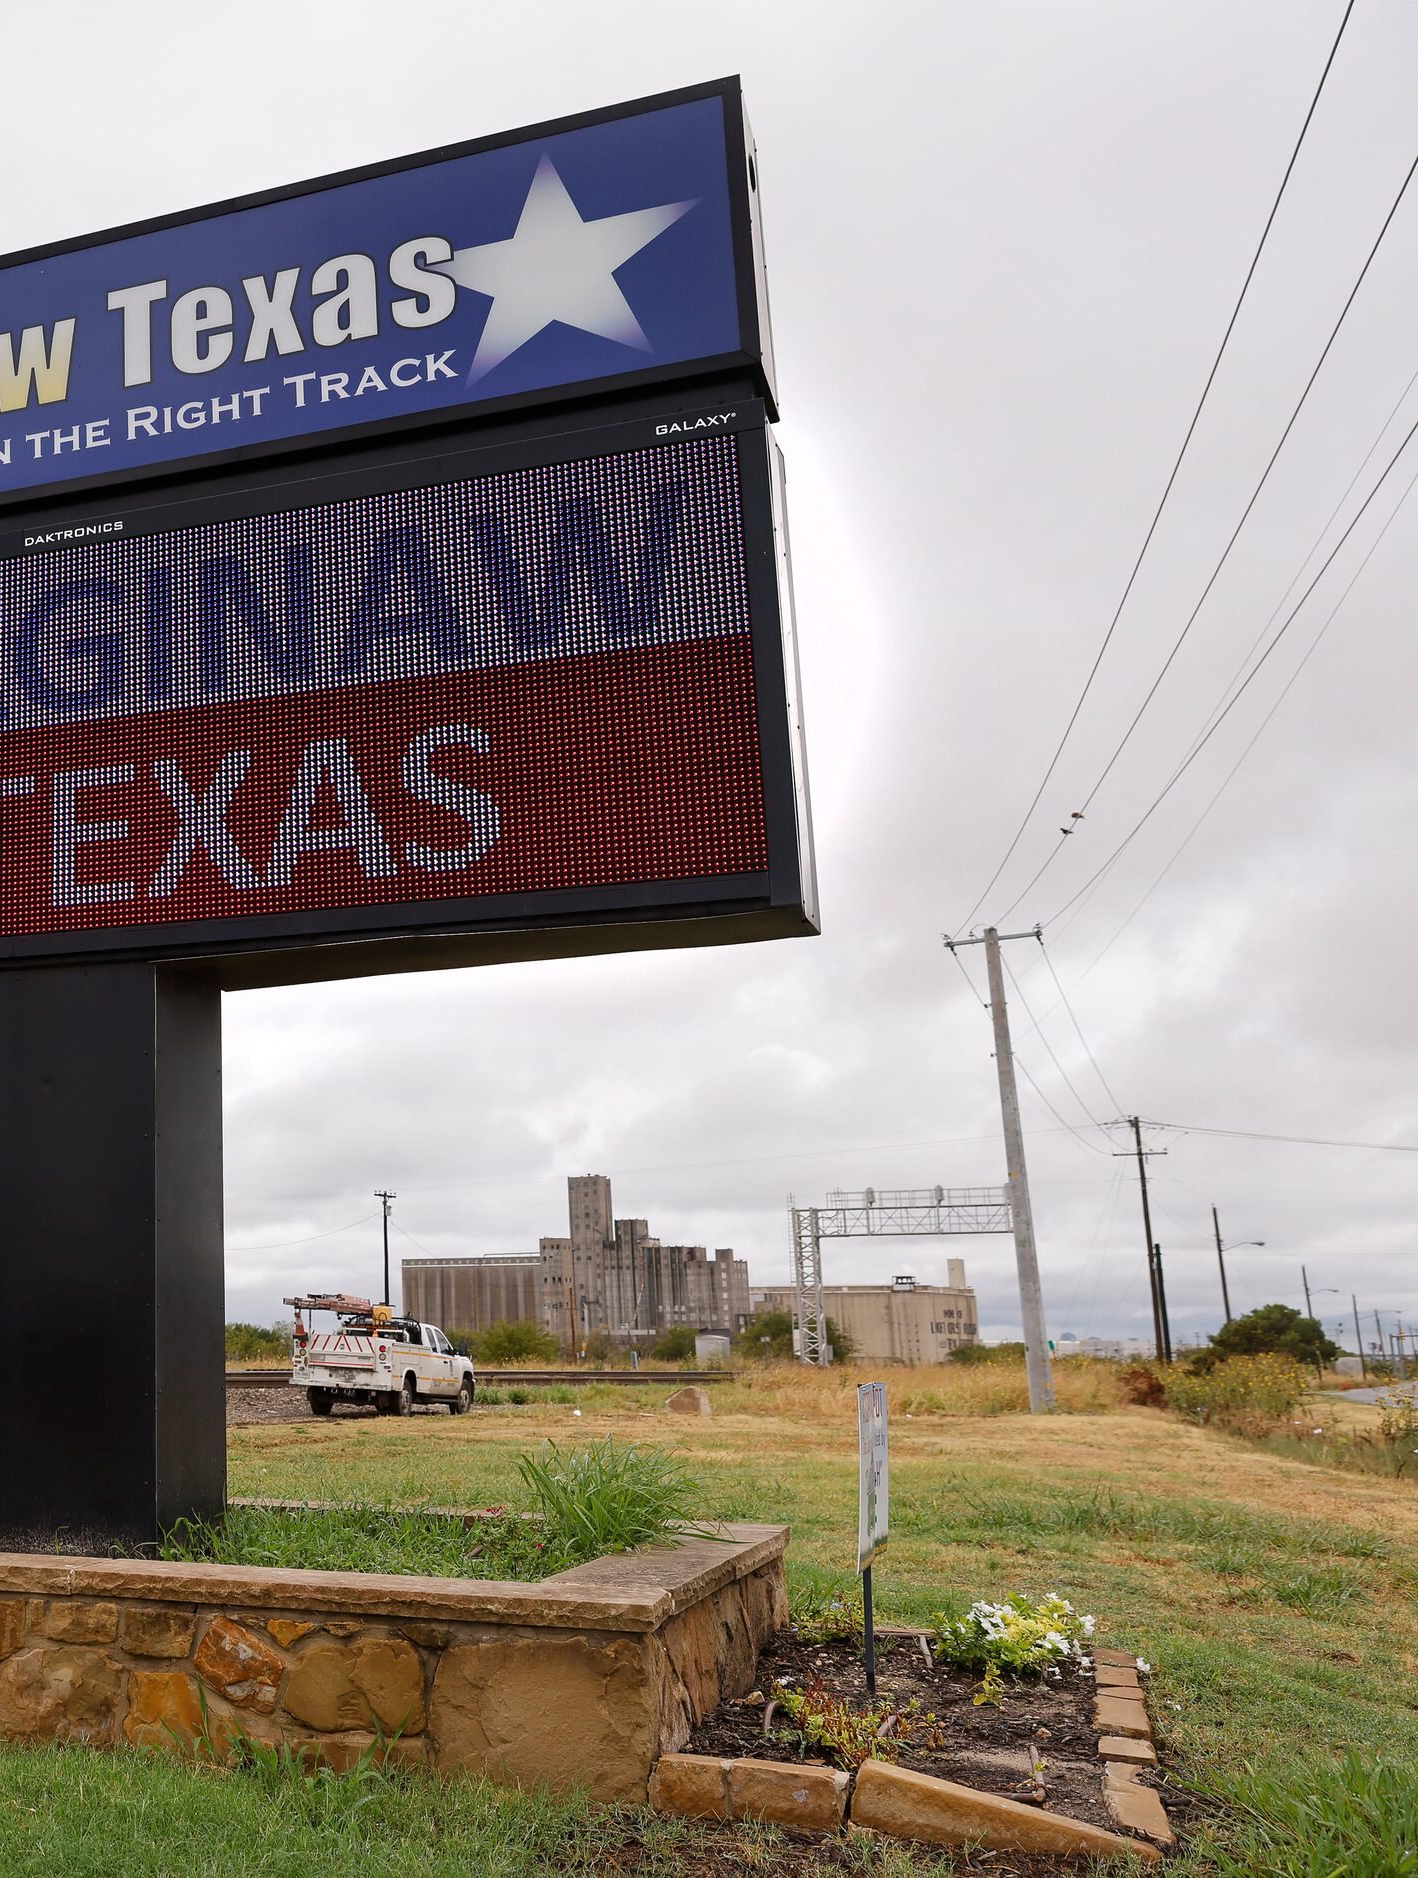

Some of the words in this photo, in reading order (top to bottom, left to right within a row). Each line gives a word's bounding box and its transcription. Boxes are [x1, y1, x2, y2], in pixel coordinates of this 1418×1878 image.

[107, 236, 457, 388] Texas
[25, 418, 111, 459] THE
[126, 386, 270, 441] RIGHT
[284, 349, 458, 409] TRACK
[24, 520, 124, 547] DAKTRONICS
